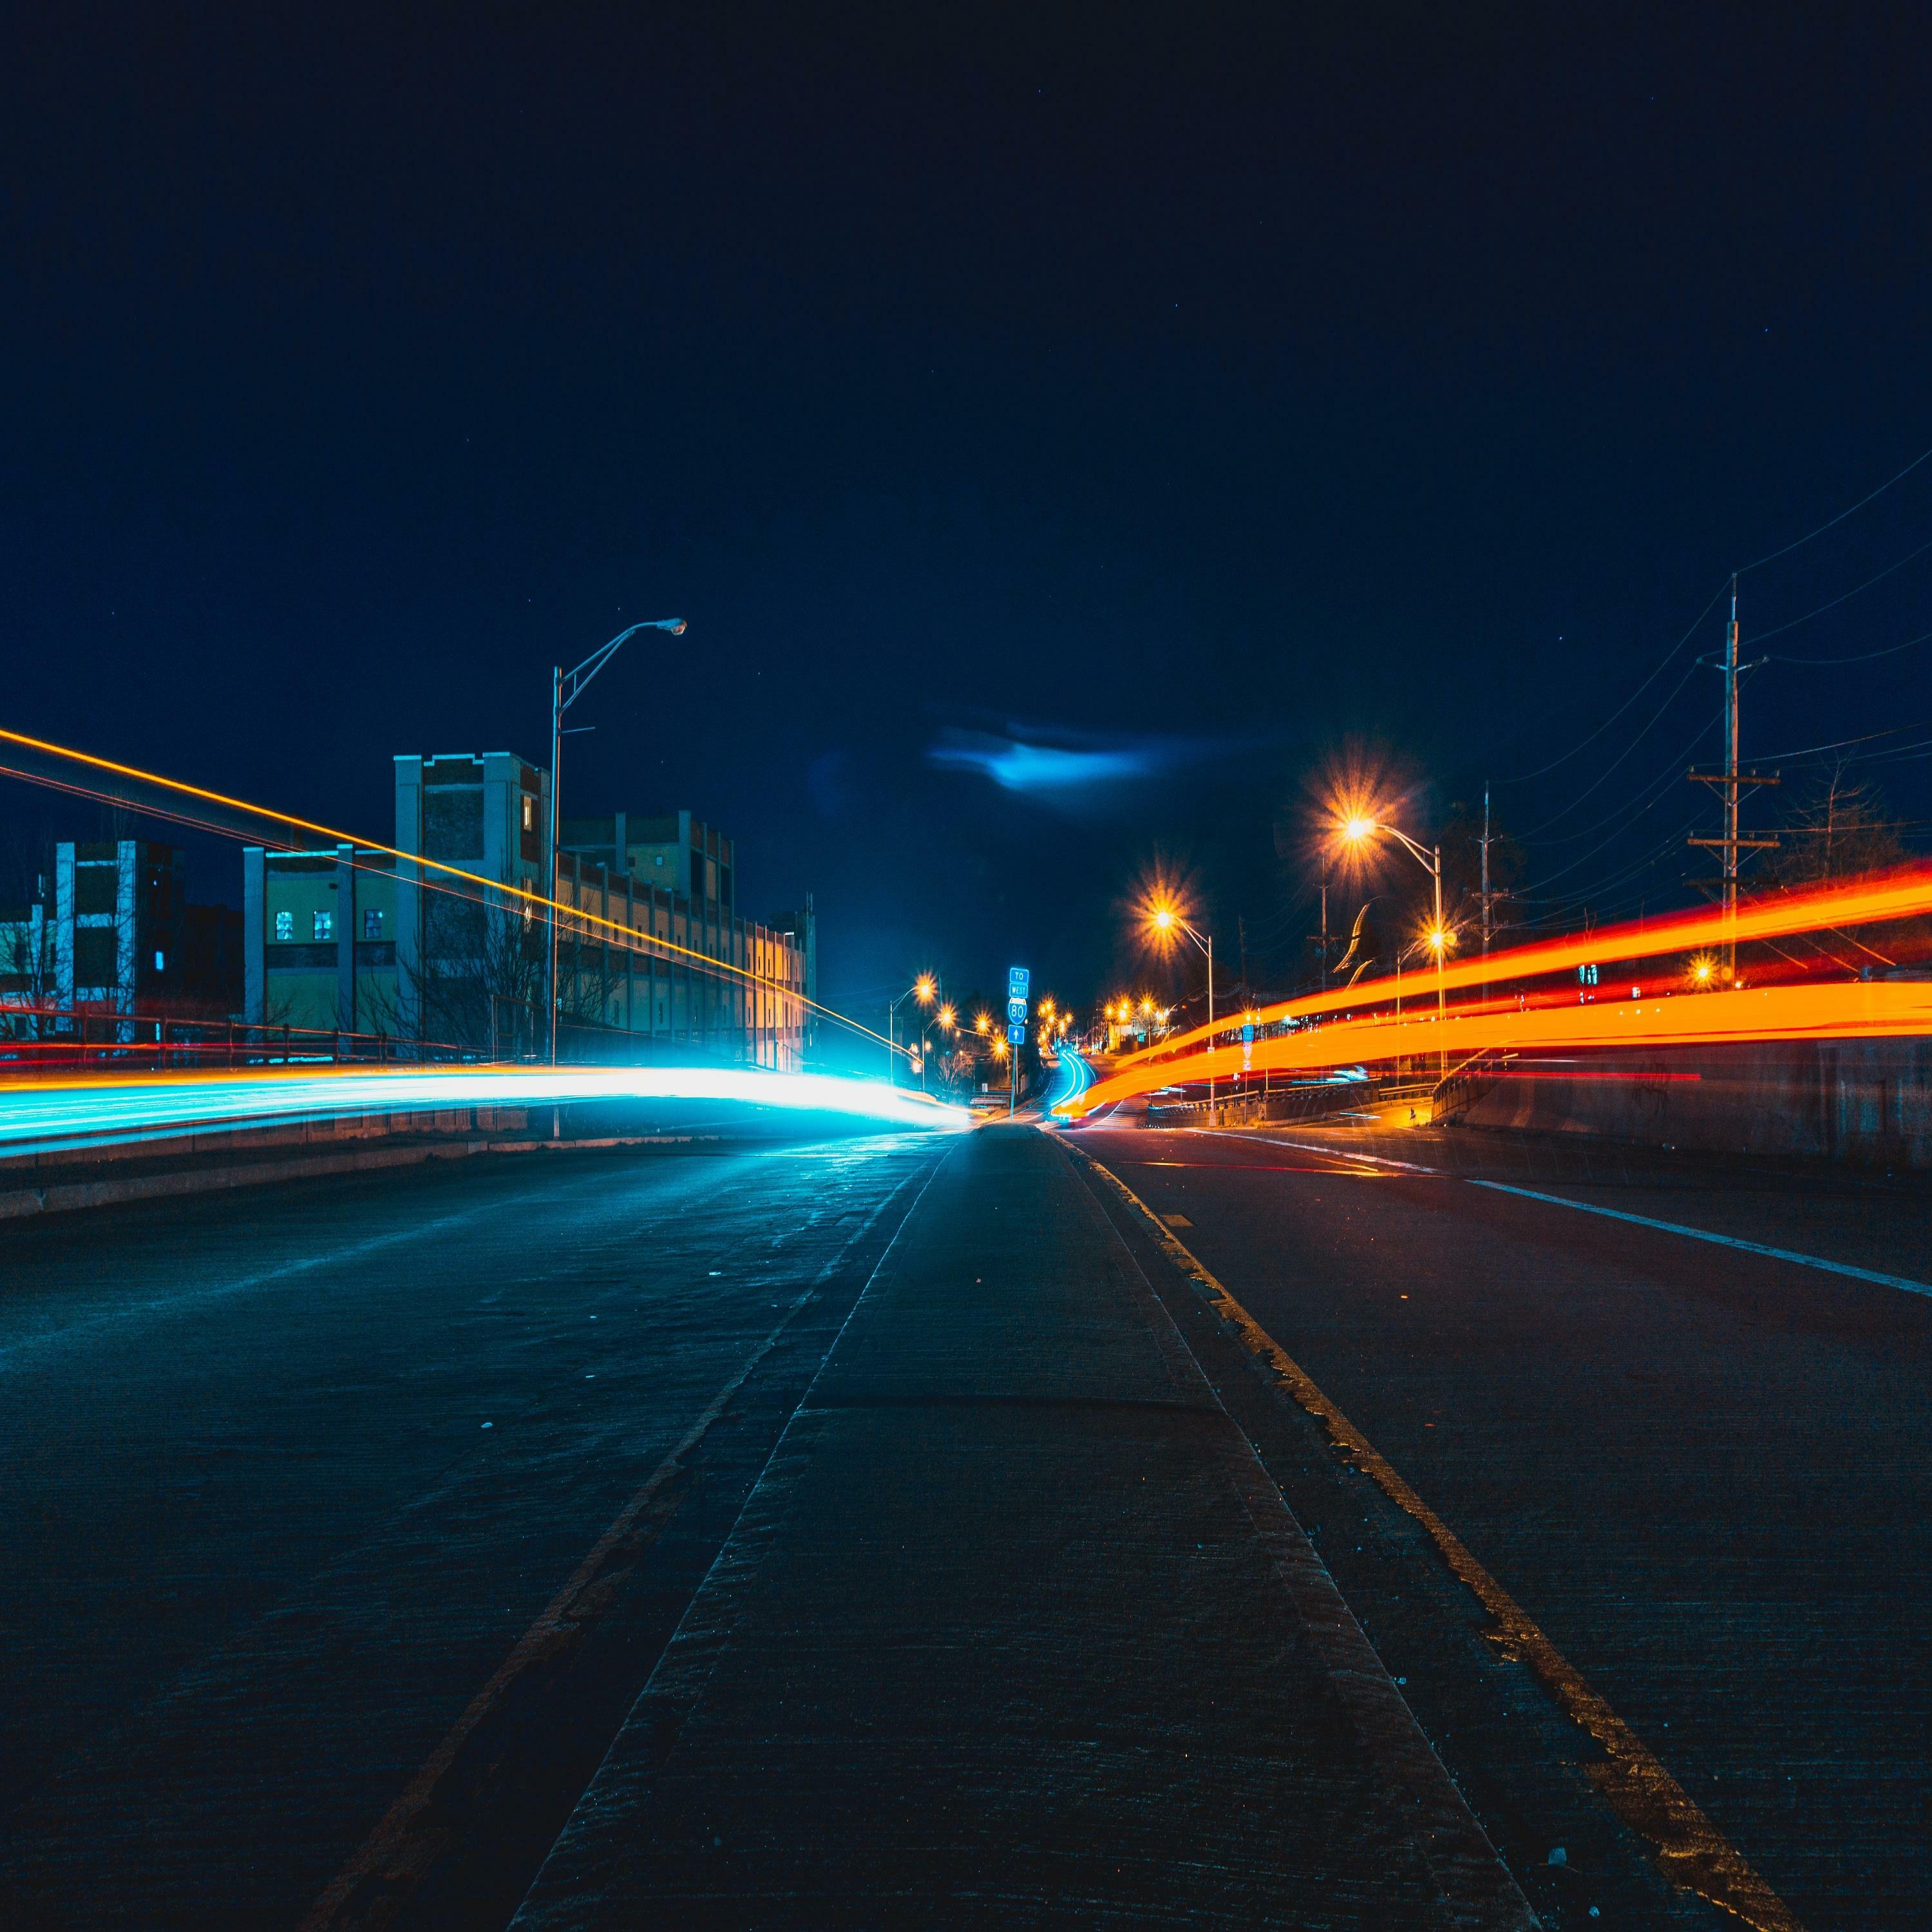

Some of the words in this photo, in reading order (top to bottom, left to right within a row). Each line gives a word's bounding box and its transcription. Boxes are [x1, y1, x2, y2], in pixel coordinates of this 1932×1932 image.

[1015, 972, 1023, 980] TO
[1012, 986, 1025, 994] WEST
[1011, 1005, 1023, 1018] 80
